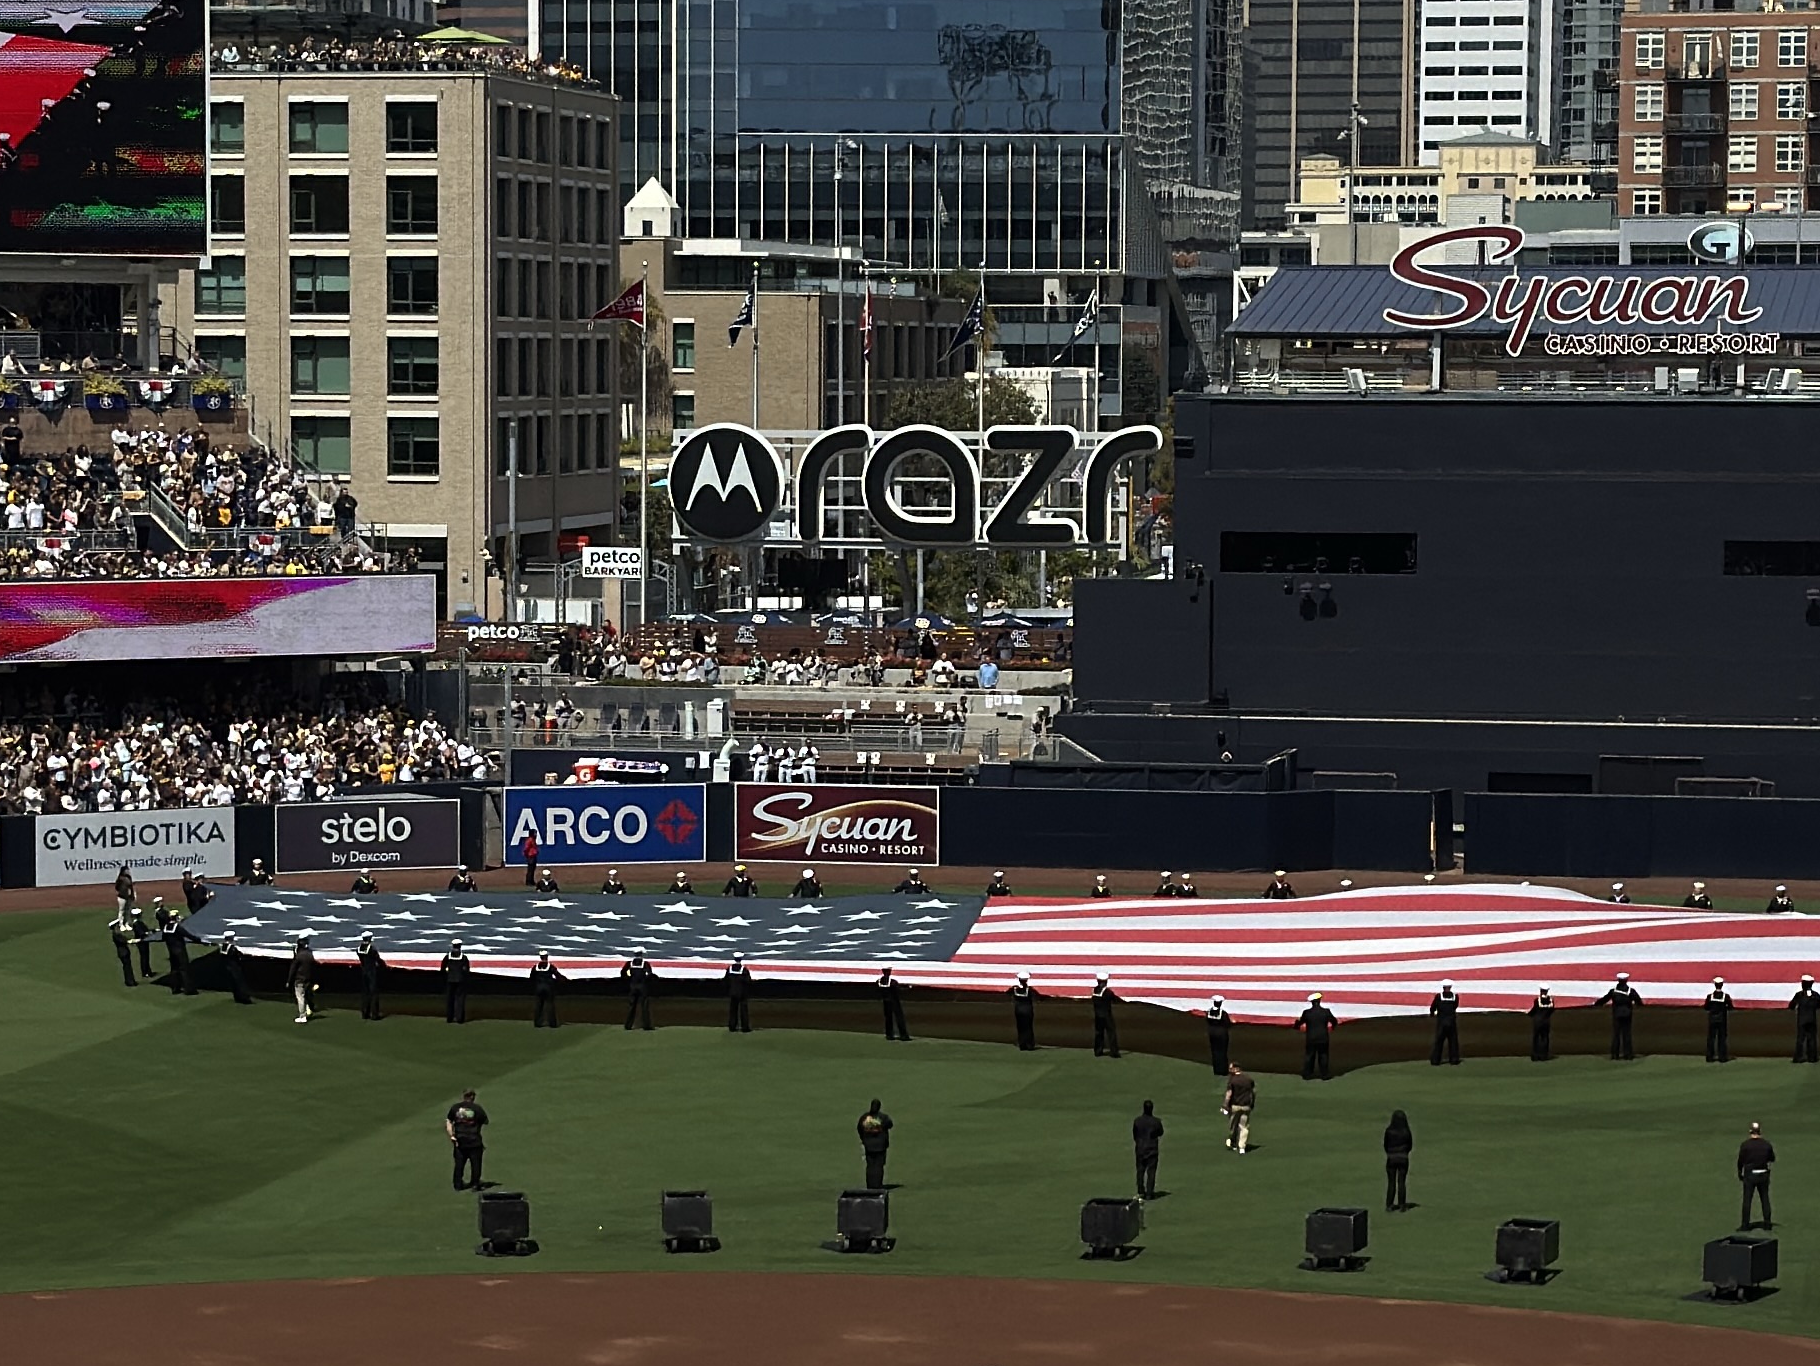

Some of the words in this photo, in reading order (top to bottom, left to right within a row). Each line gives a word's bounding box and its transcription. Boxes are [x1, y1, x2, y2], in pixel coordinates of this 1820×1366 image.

[1384, 225, 1763, 358] Sycuan
[1544, 333, 1651, 356] CASINO
[1677, 332, 1778, 356] RESORT
[795, 423, 1164, 545] razr
[590, 549, 641, 567] petco
[468, 624, 519, 641] petco
[42, 820, 226, 852] CYMBIOTIKA
[321, 805, 412, 845] stelo
[509, 805, 647, 847] ARCO
[750, 792, 918, 856] Sycuan
[63, 855, 121, 873] Wellness
[124, 853, 162, 870] made
[163, 851, 208, 871] simple.
[331, 849, 347, 865] by
[349, 848, 401, 864] Dexcom
[820, 842, 870, 857] CASINO
[879, 842, 926, 857] RESORT
